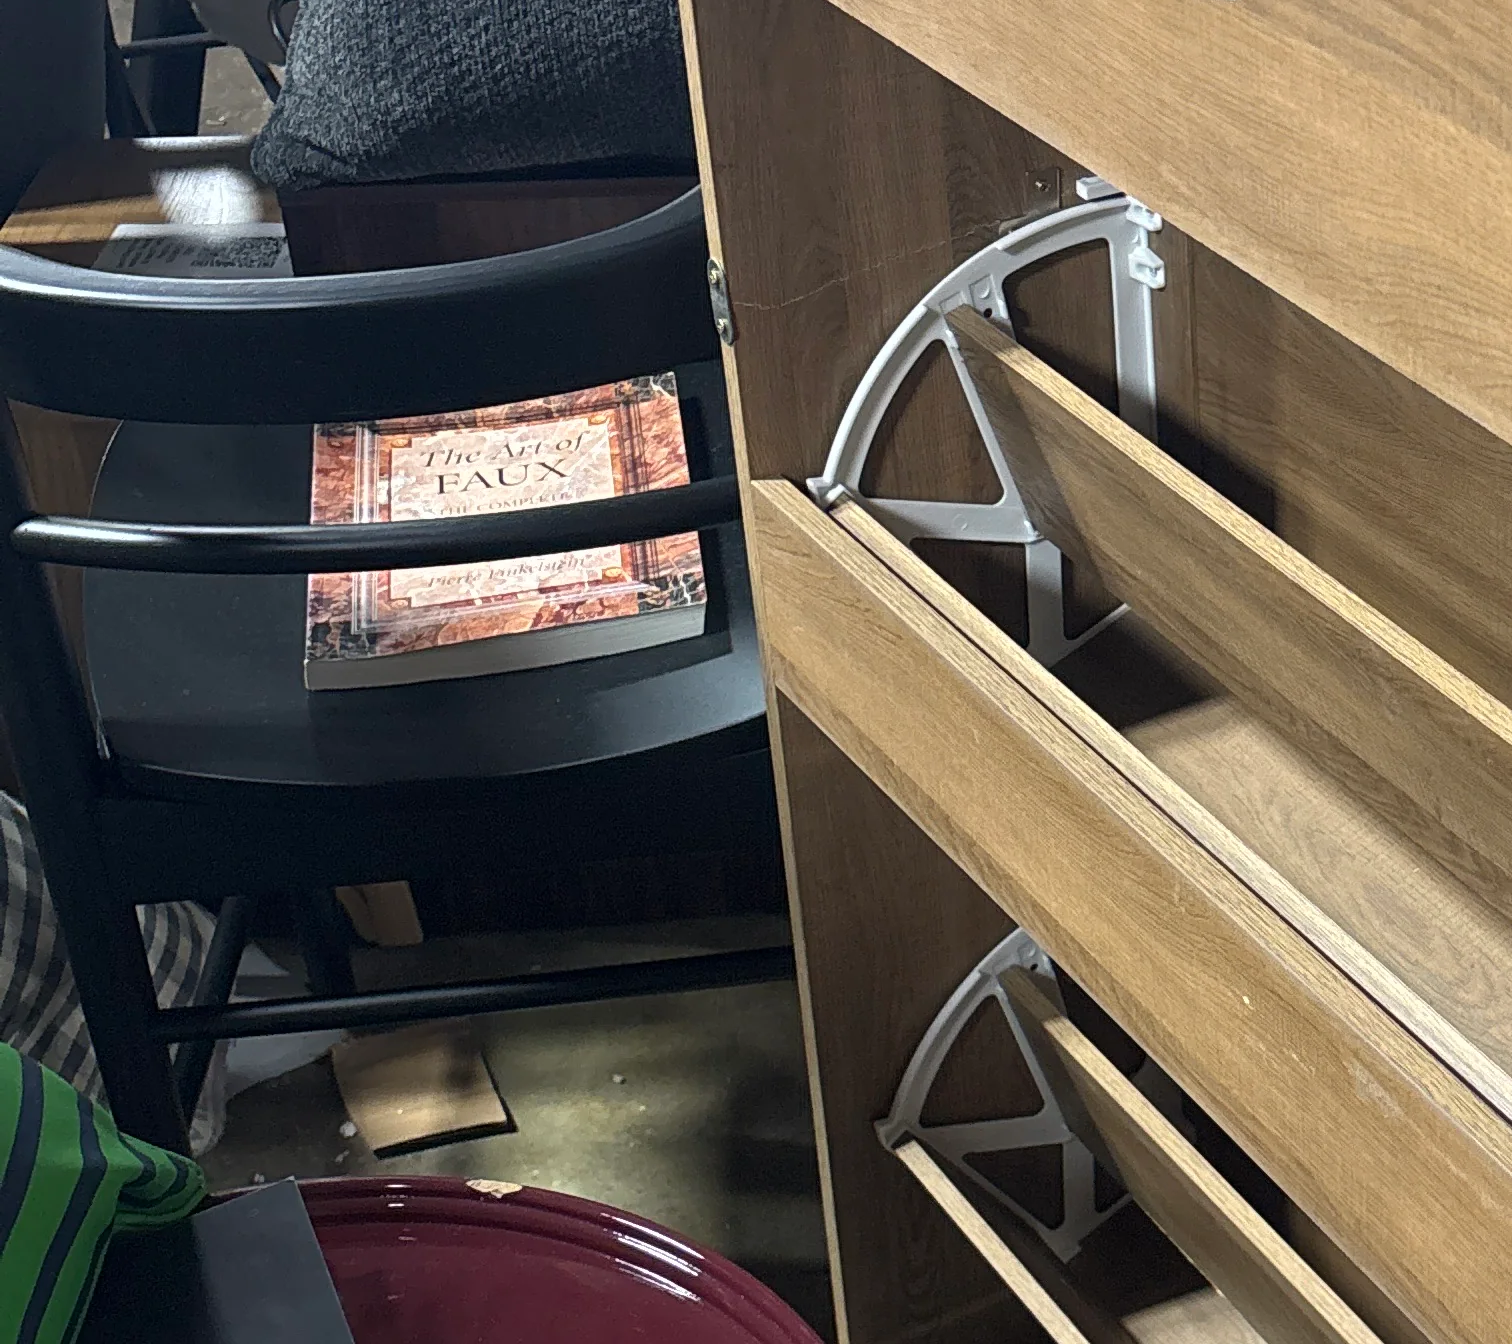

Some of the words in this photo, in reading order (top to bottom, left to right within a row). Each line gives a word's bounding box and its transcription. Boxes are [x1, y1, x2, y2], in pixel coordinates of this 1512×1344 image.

[420, 448, 481, 468] The
[493, 439, 542, 461] Art
[555, 430, 591, 452] of
[436, 458, 569, 495] FAUX
[427, 573, 482, 588] Pierre
[488, 557, 586, 580] Finkelstein
